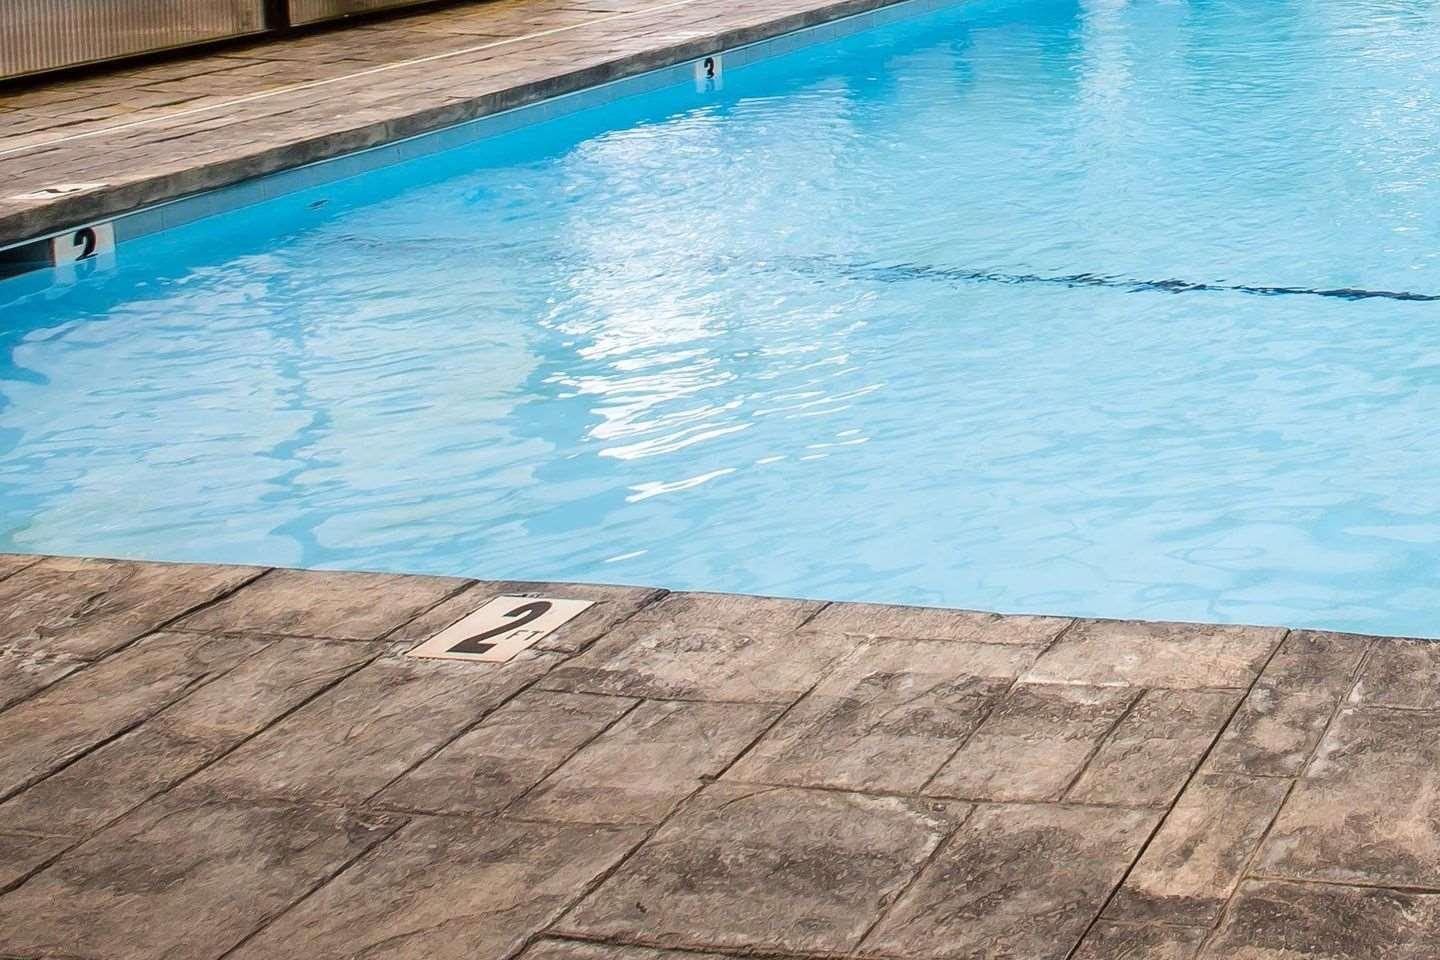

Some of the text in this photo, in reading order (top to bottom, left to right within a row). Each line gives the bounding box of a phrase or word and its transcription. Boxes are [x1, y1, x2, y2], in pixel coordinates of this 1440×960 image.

[73, 227, 98, 261] 2
[446, 601, 553, 654] 2 FT
